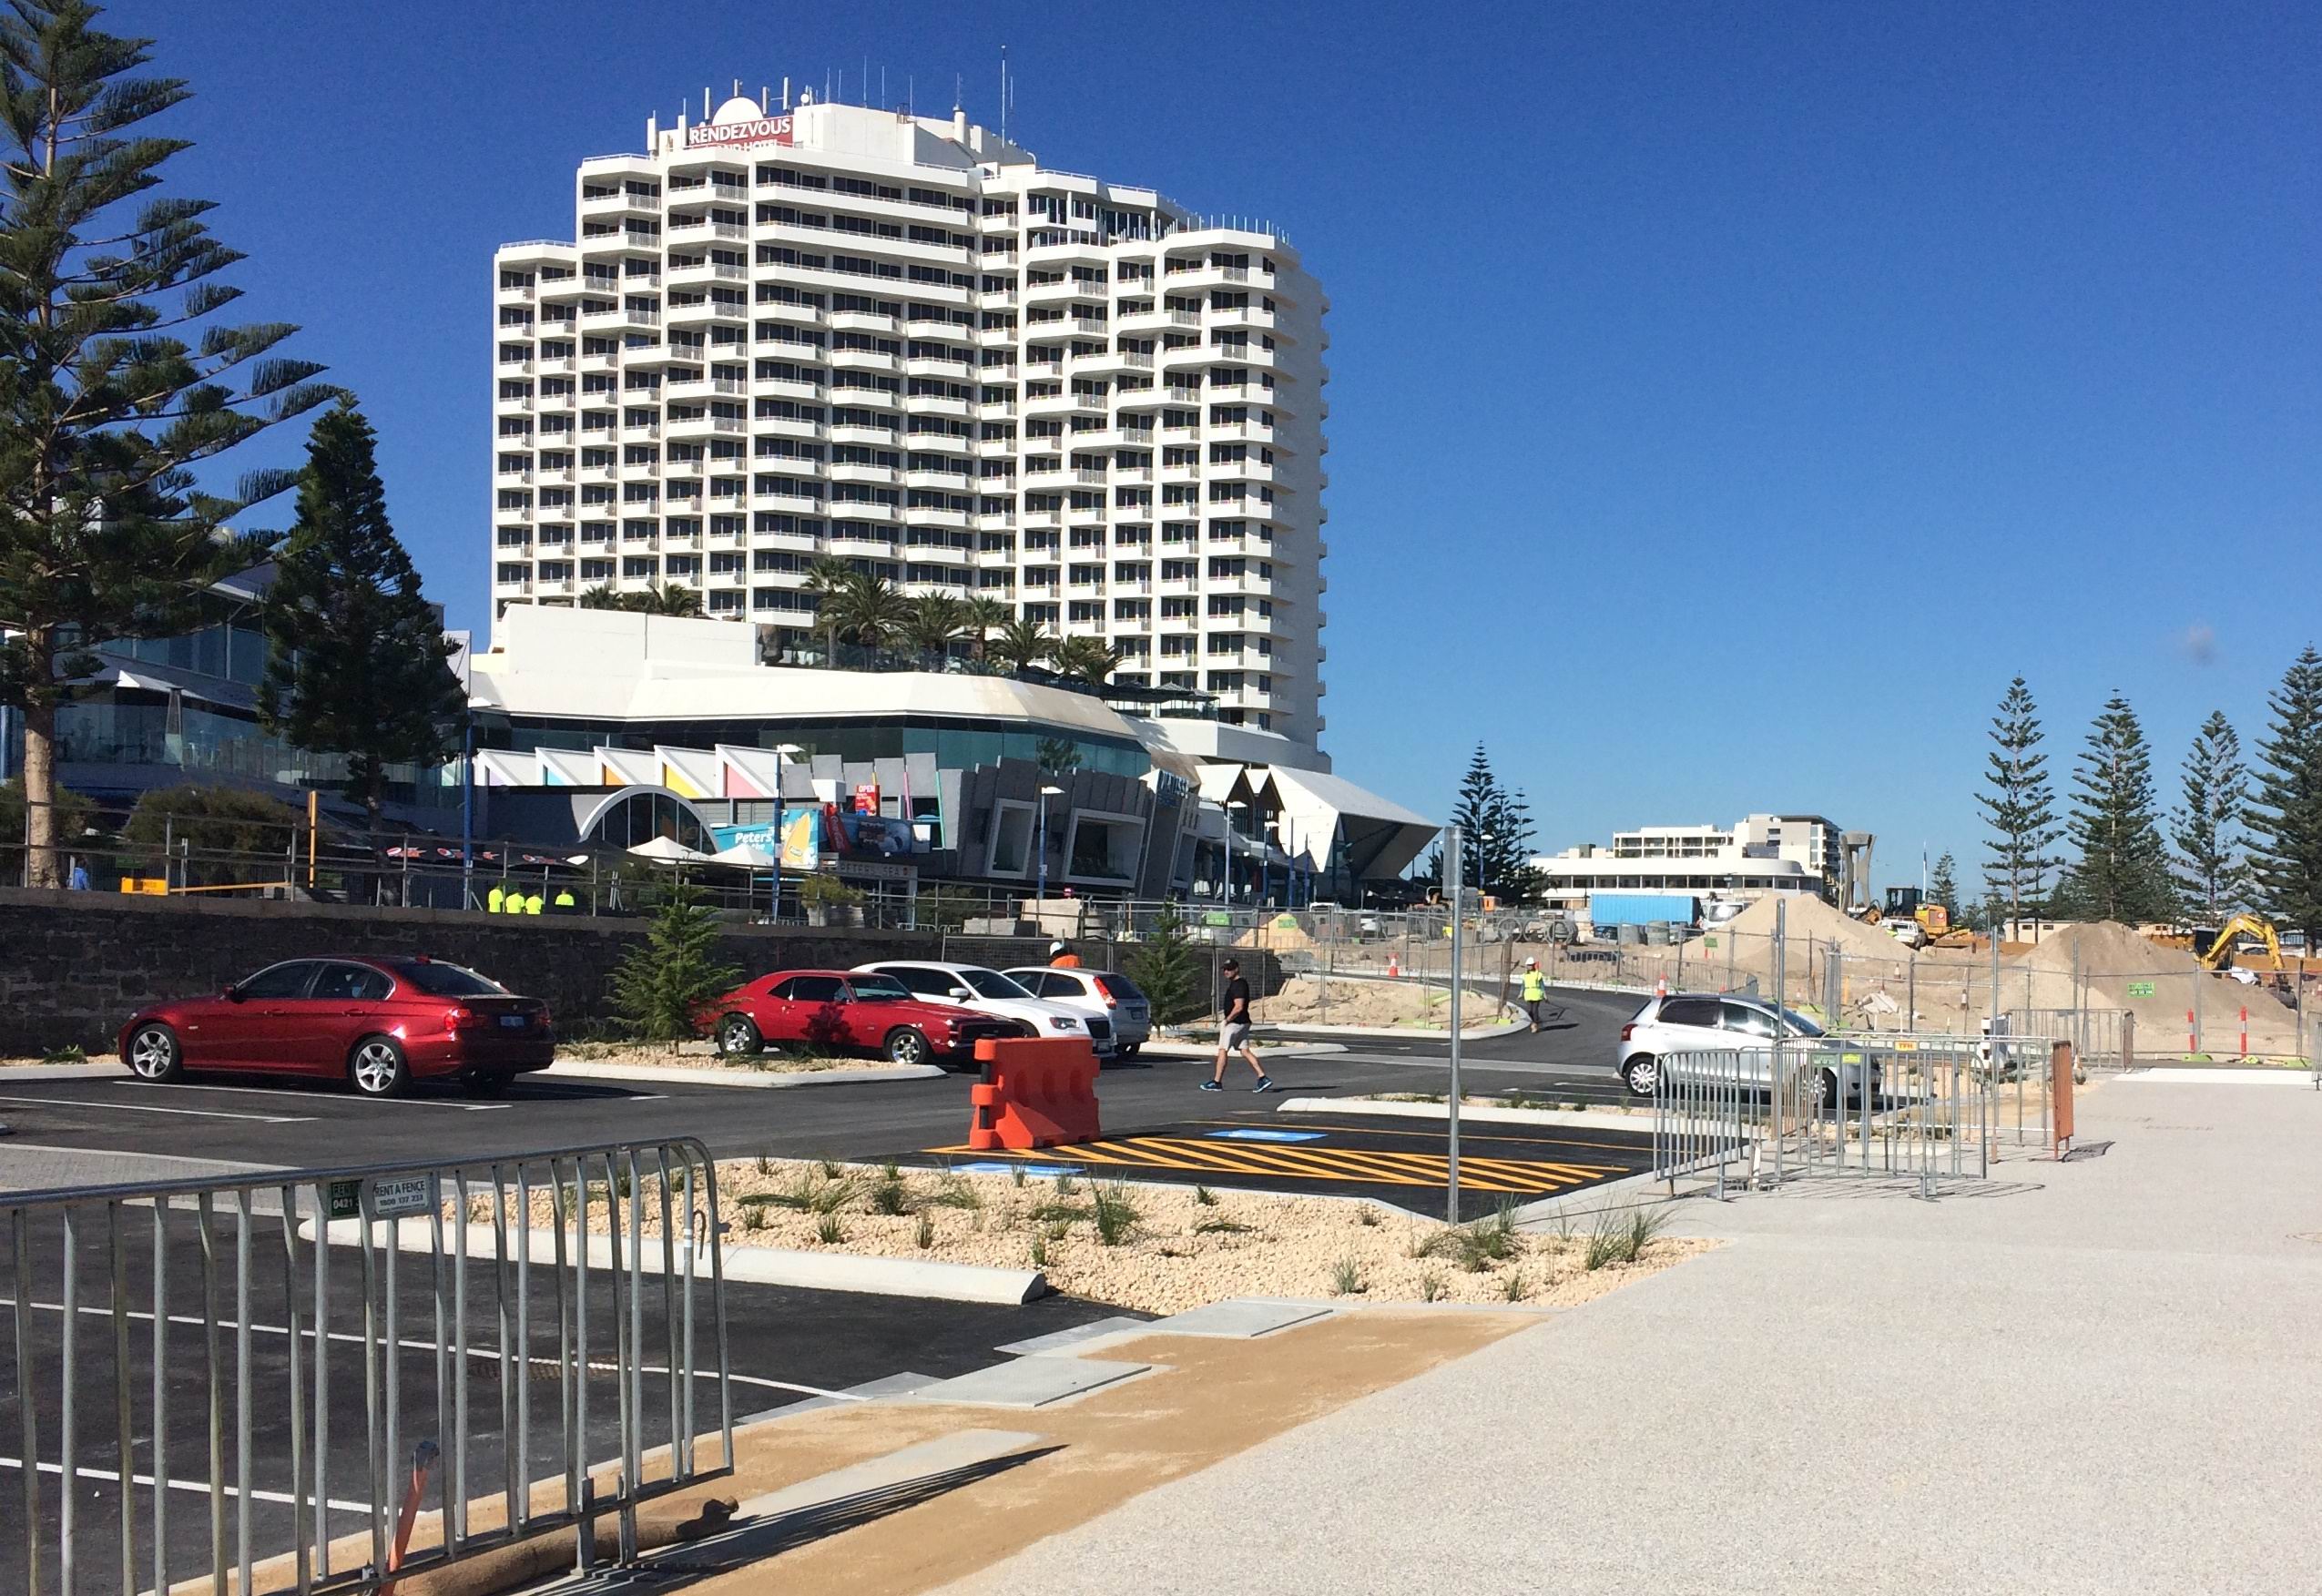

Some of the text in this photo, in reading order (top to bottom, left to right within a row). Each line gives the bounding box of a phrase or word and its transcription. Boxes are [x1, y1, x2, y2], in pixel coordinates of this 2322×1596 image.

[689, 117, 790, 144] RENDEZVOUS
[859, 785, 875, 793] OPEN
[735, 832, 772, 844] Peters
[374, 1181, 424, 1197] RENT A FENCE
[333, 1197, 352, 1210] 0421
